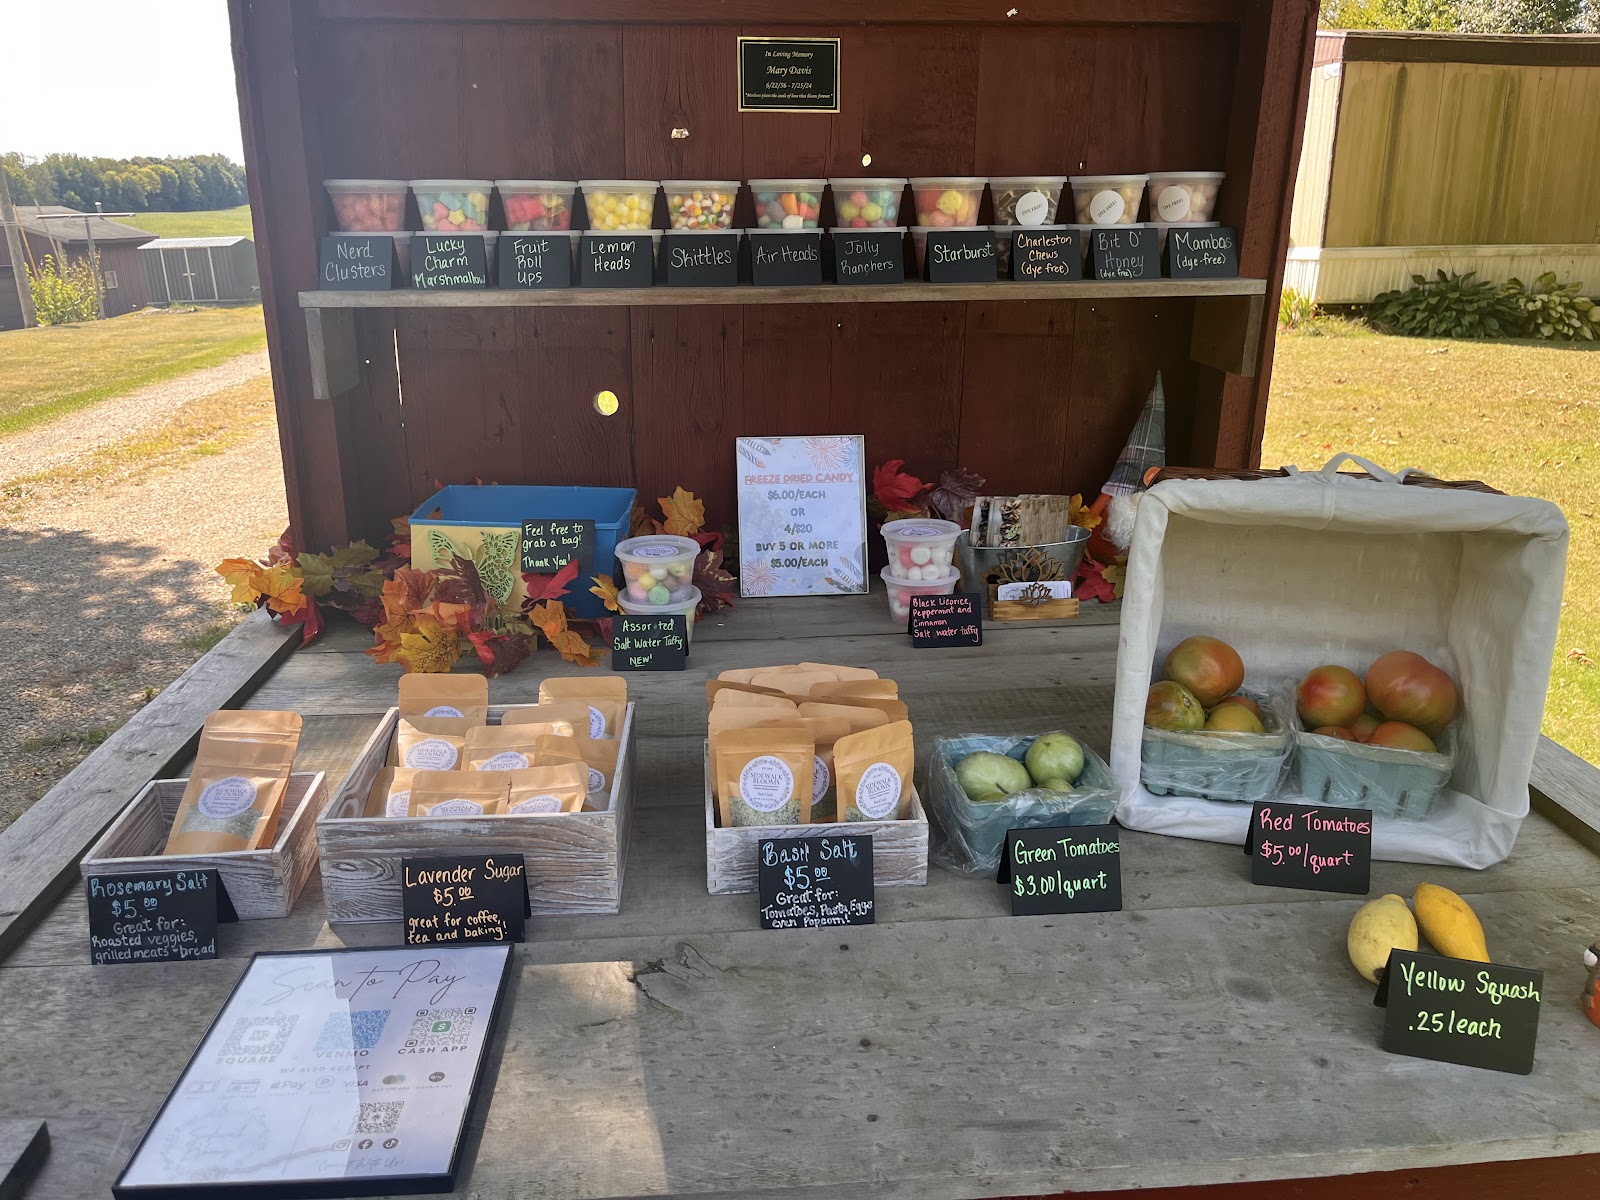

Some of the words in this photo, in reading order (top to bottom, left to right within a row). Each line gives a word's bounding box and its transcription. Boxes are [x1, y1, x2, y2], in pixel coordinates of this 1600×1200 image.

[766, 66, 788, 76] Mary
[788, 66, 812, 74] Davis
[426, 238, 466, 256] Lucky
[513, 239, 550, 254] Fruit
[590, 241, 636, 254] Lemon
[845, 240, 879, 257] Jolly
[1017, 234, 1072, 248] Charleston
[1098, 232, 1120, 250] Bit
[1129, 231, 1142, 248] O'
[337, 241, 372, 260] Nerd
[670, 247, 732, 268] Skittles
[756, 246, 775, 264] Air
[782, 245, 818, 262] Heads
[934, 242, 995, 264] Starburst
[1028, 250, 1059, 260] Chews
[424, 256, 469, 272] Charm
[516, 255, 542, 269] Roll
[594, 256, 630, 272] Heads
[840, 260, 894, 276] Ranchers
[1020, 262, 1042, 275] (dye
[1044, 262, 1070, 276] free)
[1105, 251, 1144, 276] Honey
[325, 262, 386, 282] Clusters
[1100, 268, 1116, 278] (dye
[1117, 268, 1132, 278] free)
[744, 474, 782, 486] FREEZE
[784, 473, 813, 484] DRIED
[816, 472, 854, 482] CANDY
[768, 489, 826, 500] $6.00/EACH
[790, 508, 806, 516] OR
[525, 524, 543, 536] Feel
[550, 522, 568, 535] free
[572, 523, 584, 533] to
[784, 524, 812, 535] 4/$20
[522, 538, 546, 552] grab
[562, 534, 582, 548] bag!
[756, 543, 776, 552] BUY
[780, 542, 786, 550] 5
[790, 542, 804, 550] OR
[808, 541, 838, 550] MORE
[522, 556, 550, 568] Thank
[770, 557, 828, 568] $5.00/EACH
[912, 598, 936, 608] Black
[912, 608, 954, 619] Peppermint
[958, 606, 972, 614] and
[622, 619, 674, 632] Assorted
[914, 619, 947, 628] Cinnamon
[614, 637, 630, 650] Salt
[634, 638, 662, 648] Water
[664, 635, 682, 650] Taffy
[914, 630, 931, 638] Salt
[936, 628, 958, 637] water
[959, 626, 979, 643] taffy
[630, 654, 653, 666] NEW!
[1260, 808, 1293, 830] Red
[1302, 810, 1370, 834] Tomatoes
[762, 841, 810, 866] Basil
[820, 838, 858, 860] Salt
[1015, 839, 1056, 864] Green
[1056, 838, 1120, 858] Tomatoes
[1260, 840, 1354, 874] $5.00/quart
[406, 865, 476, 888] Lavender
[484, 858, 524, 882] Sugar
[784, 865, 831, 890] $5.00
[90, 878, 172, 898] Rosemary
[176, 872, 208, 890] Salt
[1014, 870, 1107, 899] $3.00/quart
[433, 886, 474, 906] $5.00
[776, 890, 813, 906] Great
[814, 888, 838, 902] for:
[112, 898, 158, 918] $5.00
[761, 904, 819, 920] Tomatoes,
[850, 898, 872, 916] Eggs
[114, 920, 152, 934] Great
[156, 916, 186, 930] for:
[409, 915, 438, 933] great
[444, 912, 462, 926] for
[467, 910, 500, 926] coffee,
[772, 919, 798, 928] even
[803, 913, 850, 928] Popcorn!
[92, 934, 142, 948] Roasted
[148, 930, 198, 948] veggies,
[408, 930, 430, 944] tea
[436, 930, 458, 941] and
[464, 920, 508, 940] baking!
[96, 948, 131, 965] grilled
[134, 947, 169, 958] meats
[180, 938, 215, 958] bread
[263, 966, 352, 1006] Scan
[348, 966, 390, 1002] to
[392, 960, 466, 1006] Pay
[1400, 962, 1466, 996] Yellow
[1476, 970, 1540, 1004] Squash
[316, 1050, 370, 1059] VENMO
[398, 1047, 436, 1055] CASH
[216, 1055, 278, 1064] SQUARE
[282, 1080, 306, 1090] Pay
